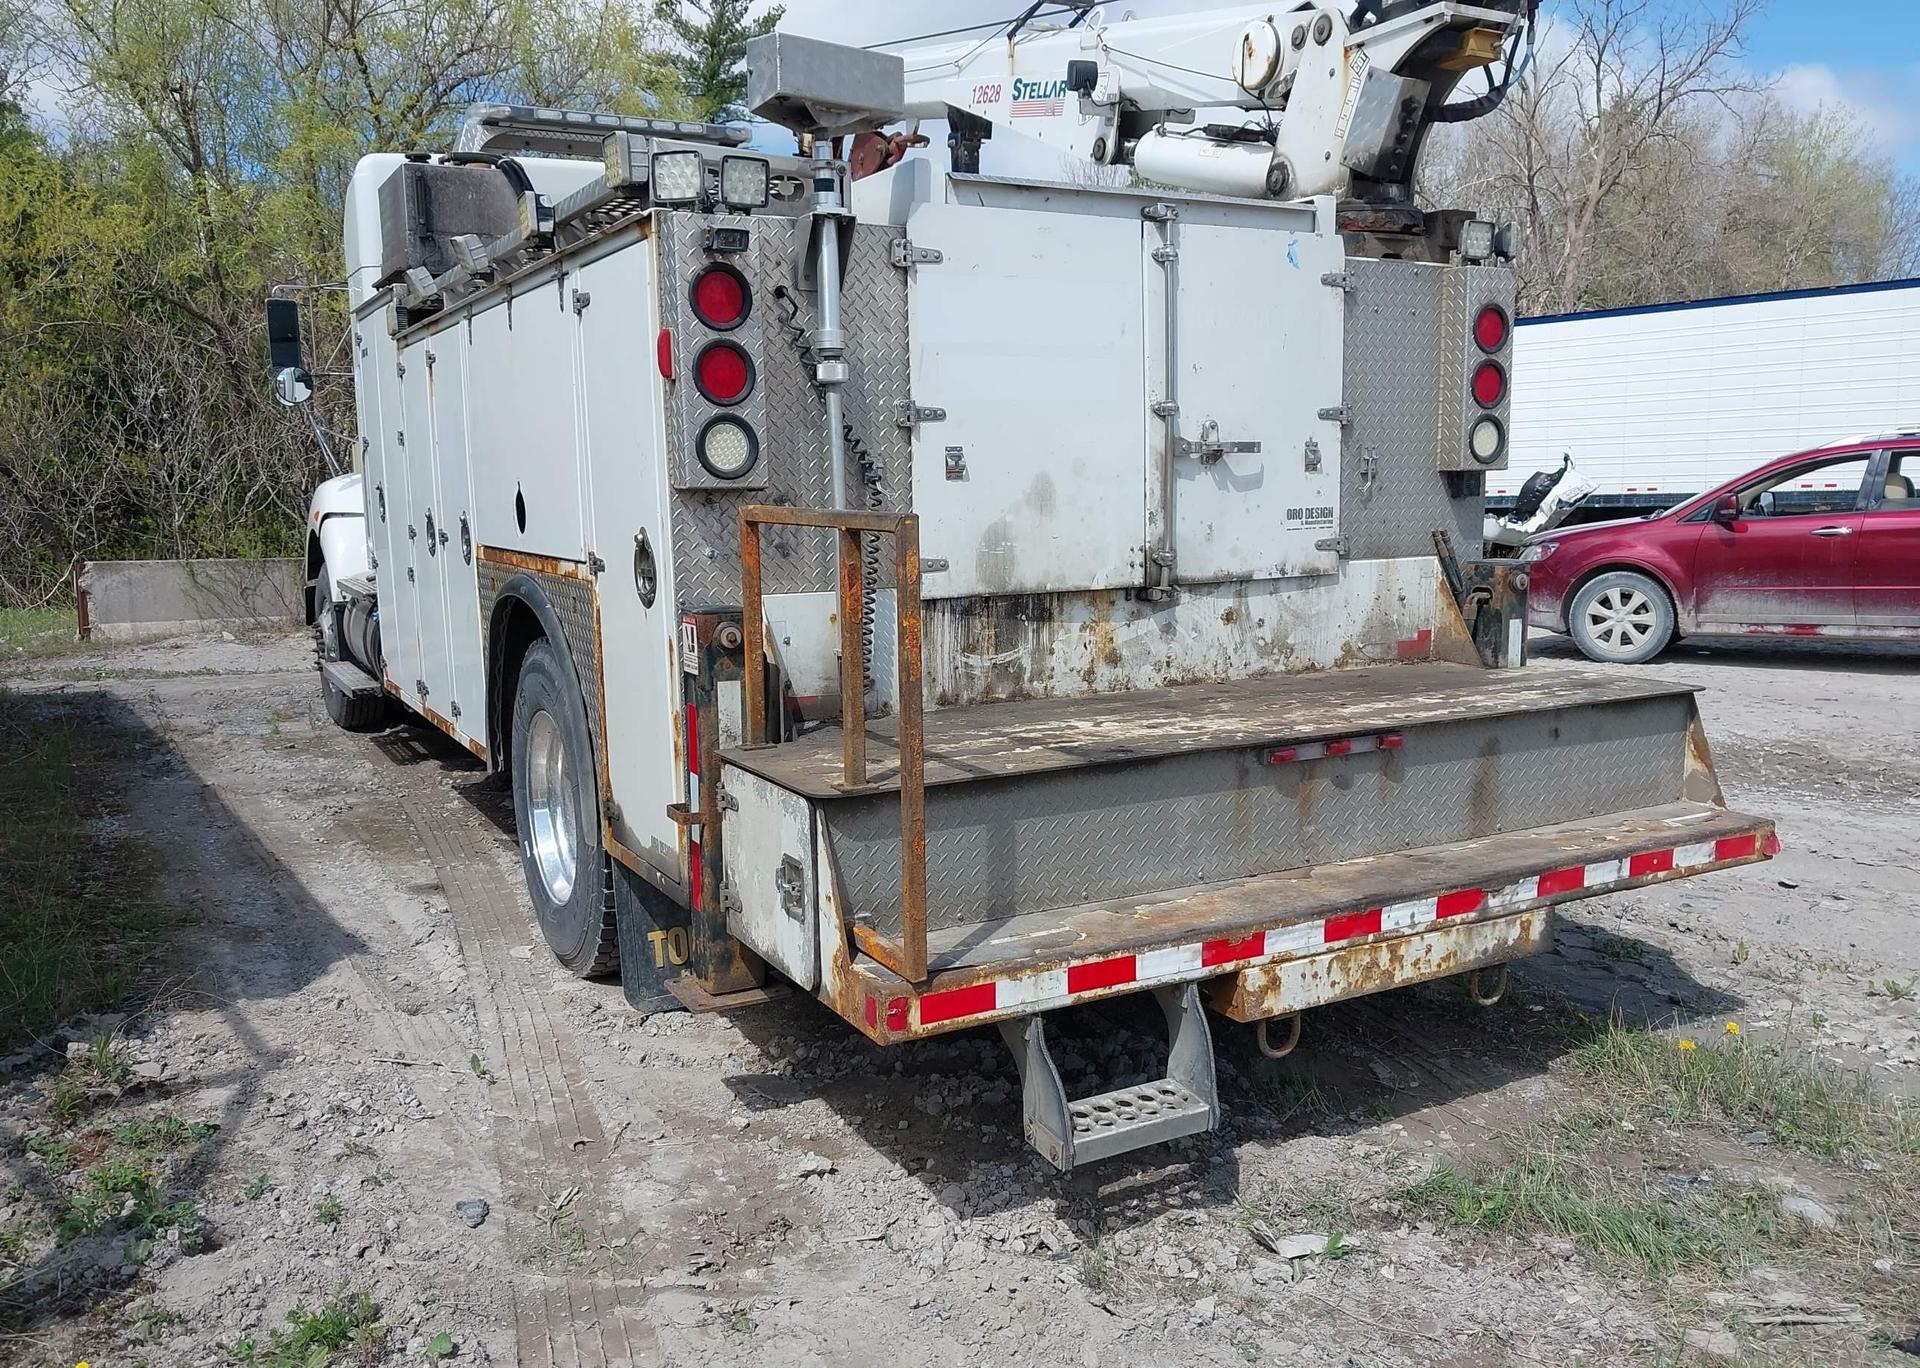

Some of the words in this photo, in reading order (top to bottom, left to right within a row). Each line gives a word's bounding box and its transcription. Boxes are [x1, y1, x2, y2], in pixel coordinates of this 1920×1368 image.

[972, 83, 1001, 105] 12628
[1012, 77, 1067, 101] STELLAR
[1286, 508, 1303, 520] ORO
[1305, 506, 1333, 519] DESIGN
[647, 926, 692, 968] TO
